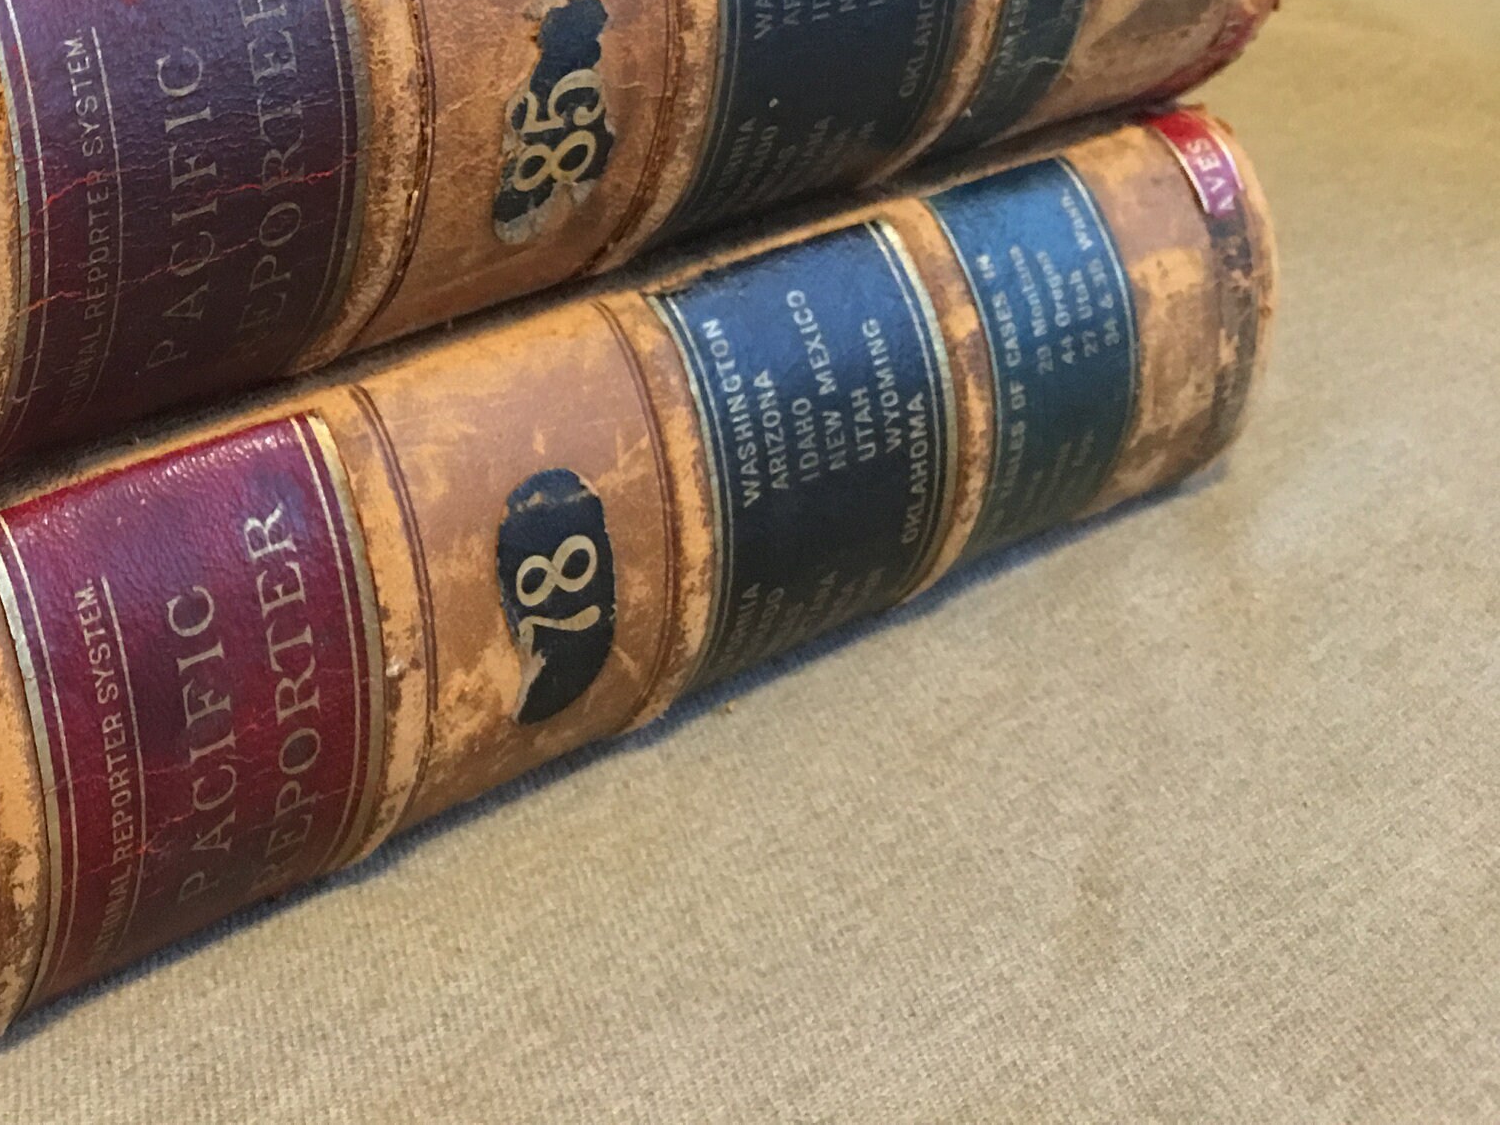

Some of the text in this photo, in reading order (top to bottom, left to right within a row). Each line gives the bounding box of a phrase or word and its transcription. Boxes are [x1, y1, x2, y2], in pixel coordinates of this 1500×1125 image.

[506, 68, 605, 192] 85
[1189, 136, 1236, 213] AVES
[84, 169, 112, 318] REPORTER
[144, 45, 220, 371] PACIFIC
[975, 253, 996, 280] IN
[992, 289, 1023, 368] CASES
[1008, 243, 1048, 337] Montana
[1036, 249, 1071, 327] Oregon
[1070, 268, 1094, 320] Utah
[701, 317, 762, 509] WASHINGTON
[752, 368, 790, 491] ARIZONA
[786, 288, 848, 471] NEW MEXICO
[792, 396, 820, 482] IDAHO
[850, 386, 877, 463] UTAH
[861, 316, 903, 455] WYOMING
[1009, 379, 1027, 410] OF
[901, 391, 929, 544] OKLAHOMA
[73, 576, 120, 702] SYSTEM.
[515, 534, 602, 649] 78
[165, 583, 240, 901] PACIFIC
[241, 499, 324, 885] REPORTER
[101, 711, 135, 861] REPORTER
